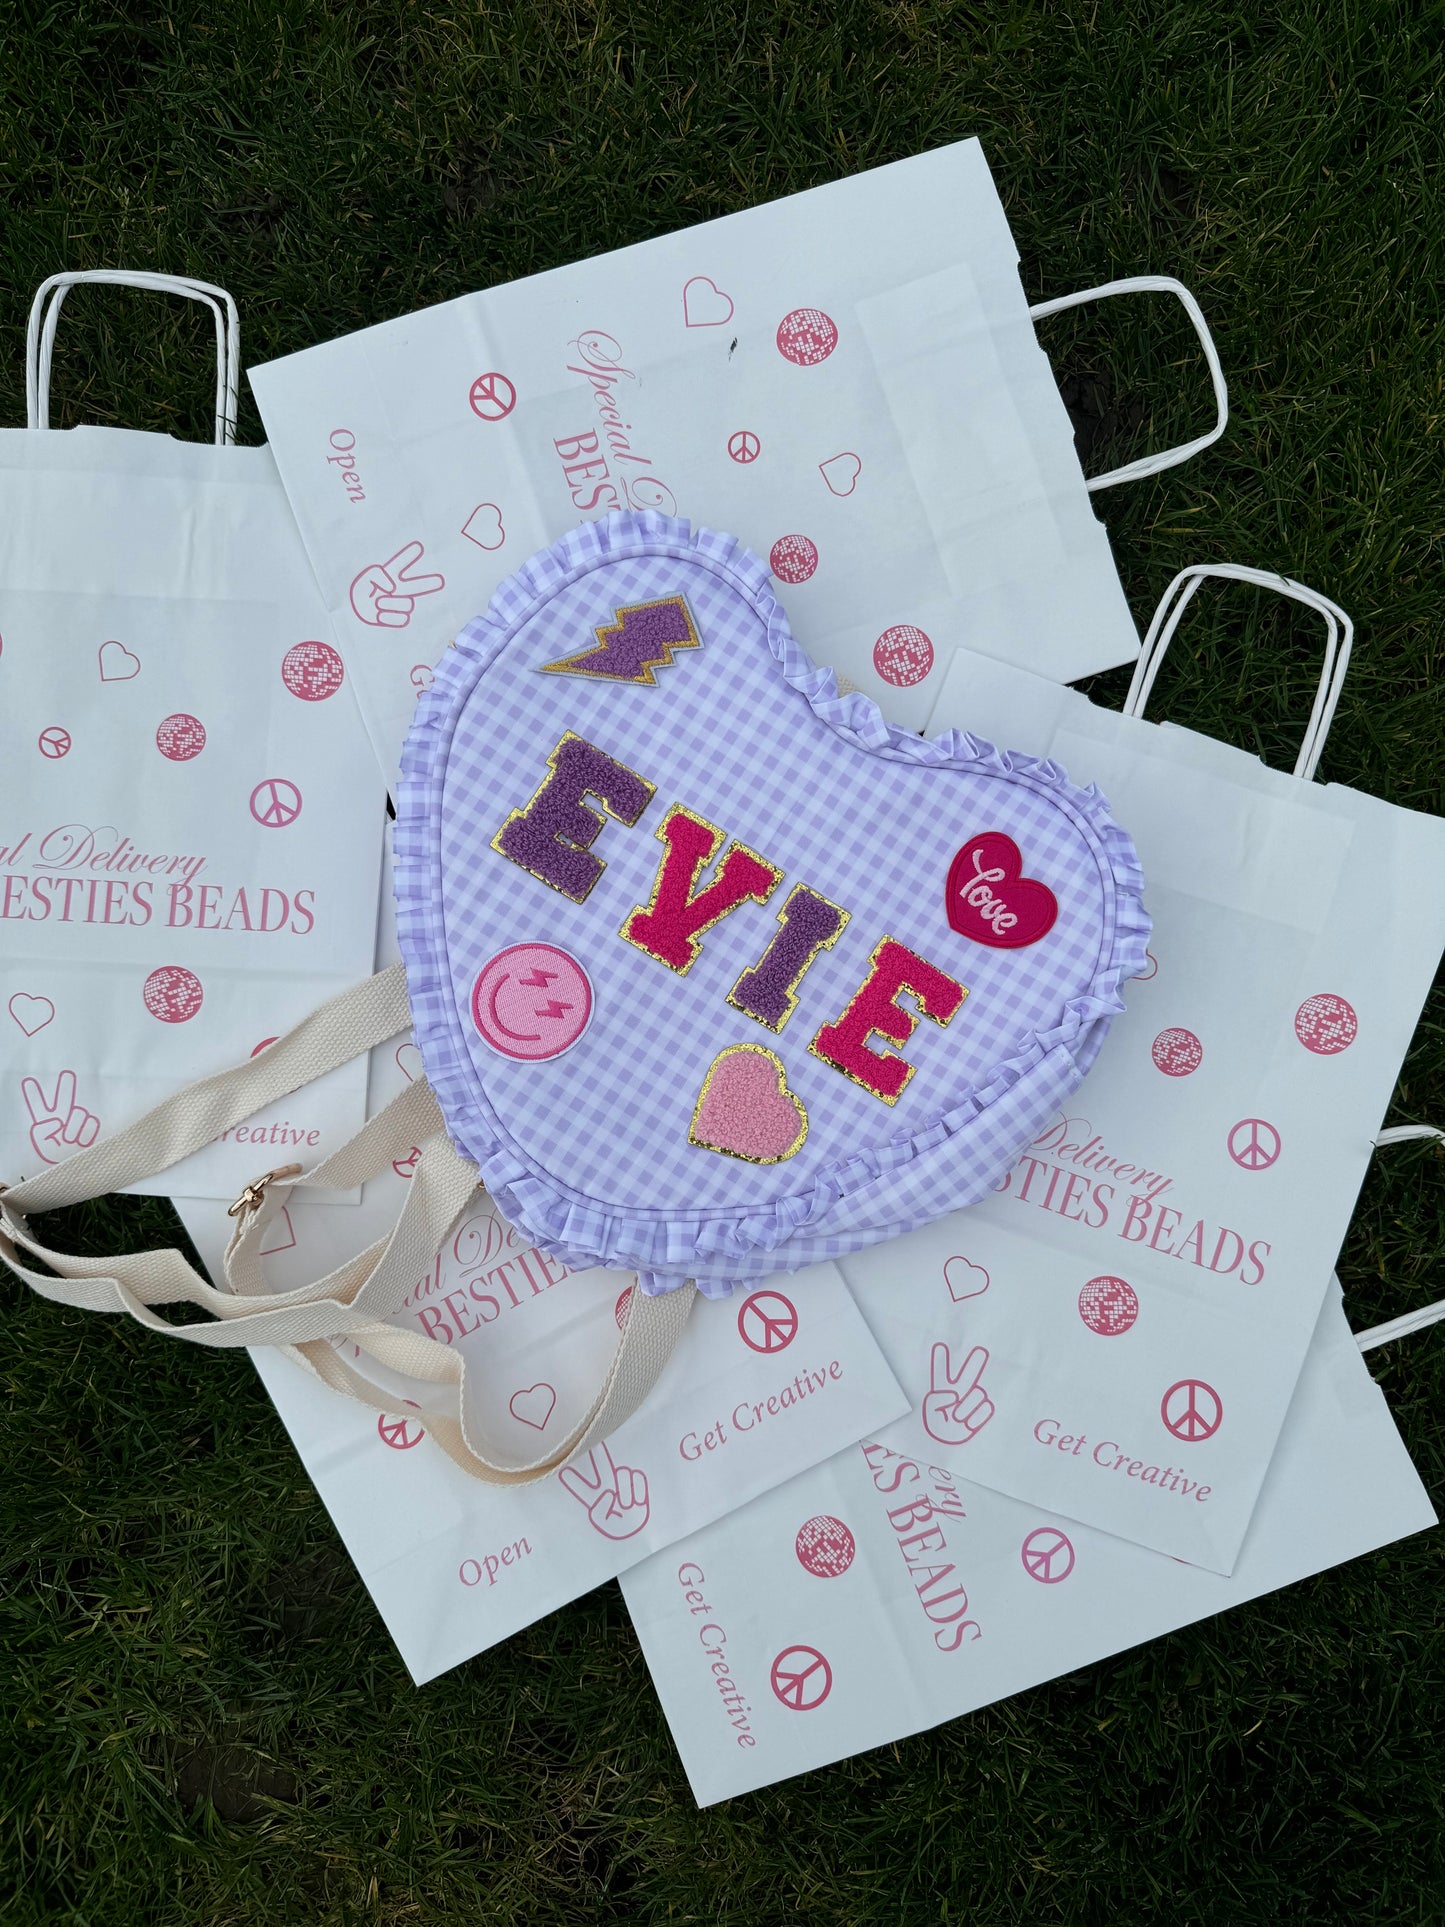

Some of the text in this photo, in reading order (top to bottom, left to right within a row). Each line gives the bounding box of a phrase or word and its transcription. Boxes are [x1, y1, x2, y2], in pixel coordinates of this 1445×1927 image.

[566, 330, 653, 466] Special
[327, 428, 367, 503] Open
[0, 874, 316, 935] ESTIES BEADS
[32, 823, 208, 894] Delivery
[490, 729, 970, 1108] EVIE
[211, 1121, 321, 1147] reative
[993, 1155, 1272, 1286] TIES BEADS
[414, 1247, 577, 1345] BESTIE
[679, 1360, 844, 1461] Get Creative
[1033, 1418, 1212, 1502] Get Creative
[459, 1536, 533, 1587] Open
[886, 1493, 983, 1653] BEADS
[678, 1562, 757, 1749] Get Creative
